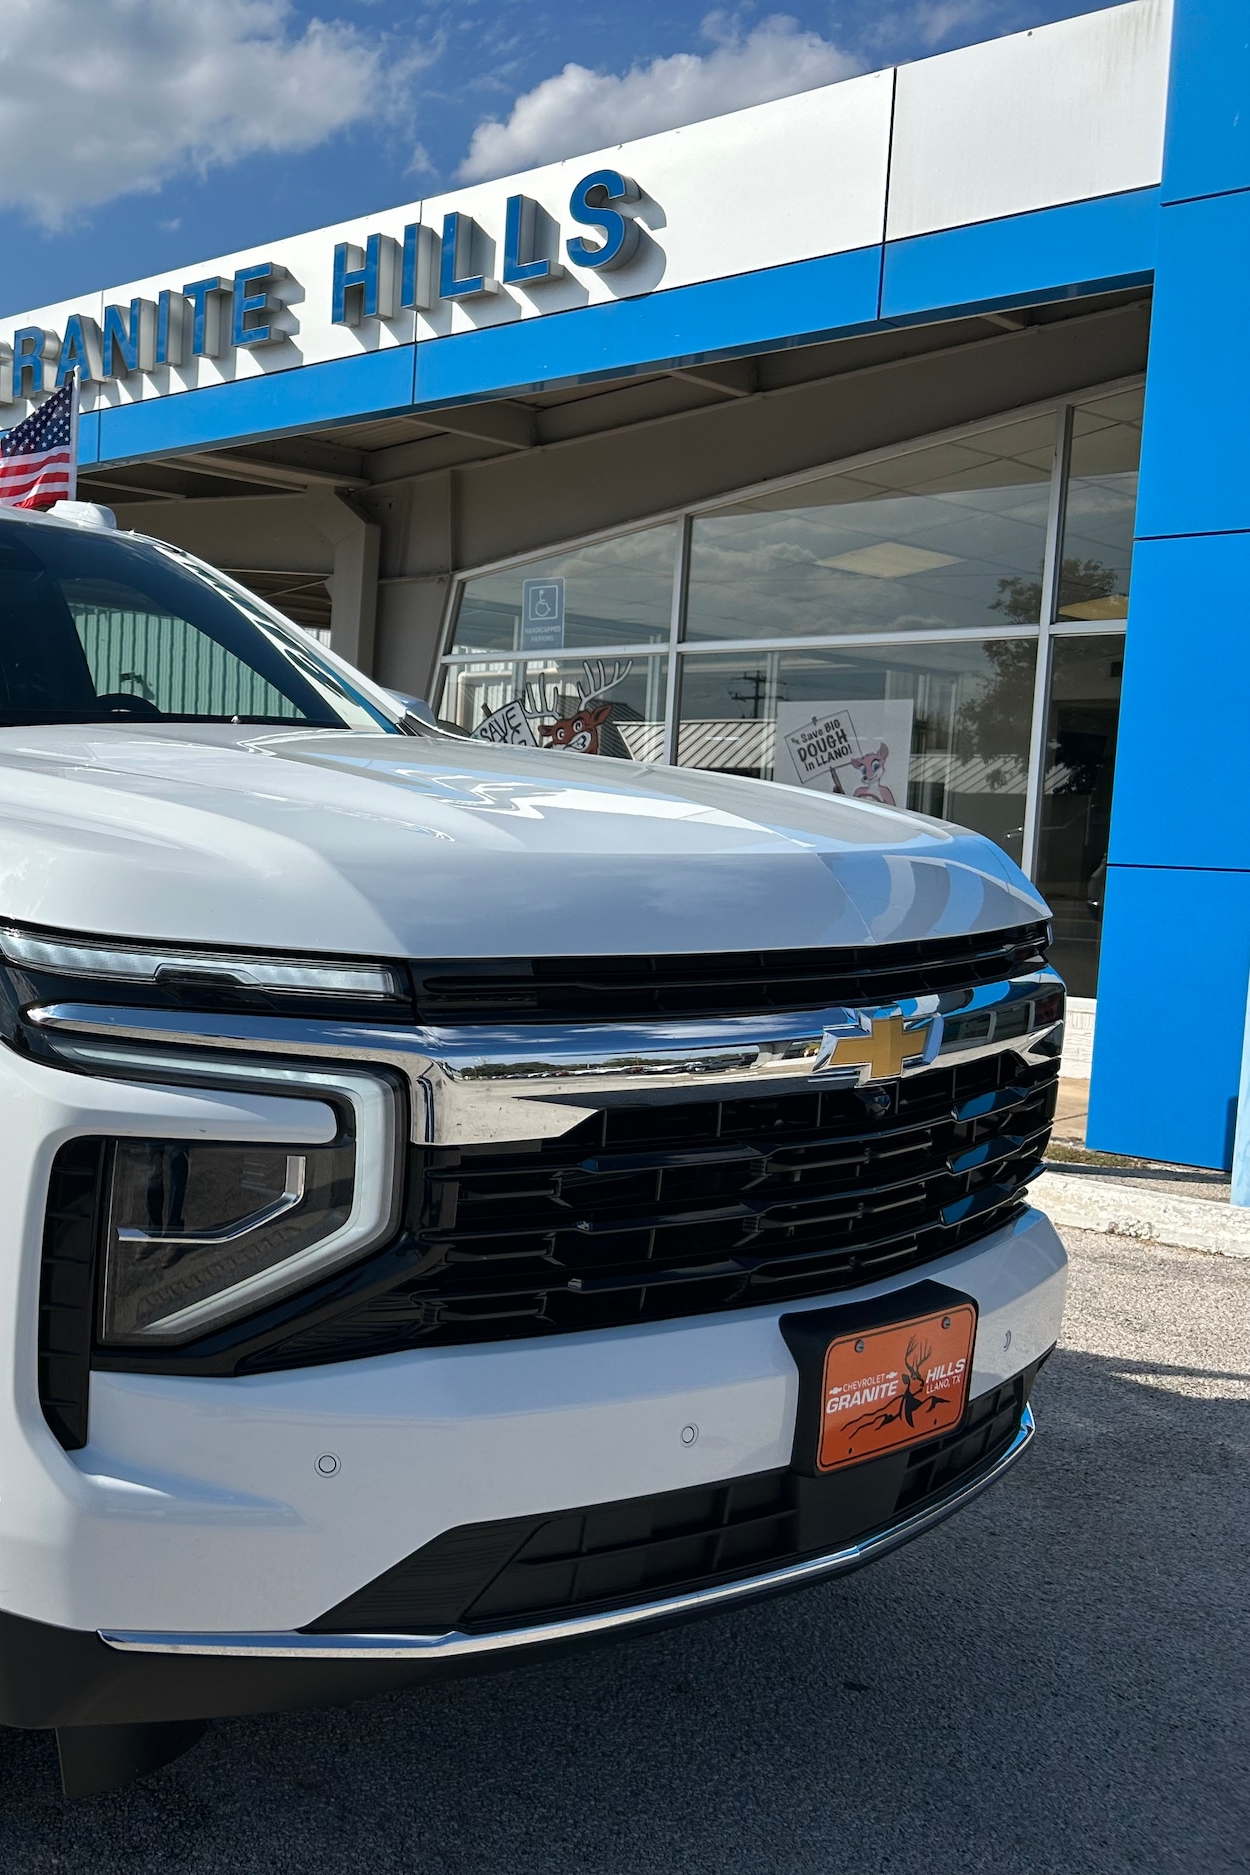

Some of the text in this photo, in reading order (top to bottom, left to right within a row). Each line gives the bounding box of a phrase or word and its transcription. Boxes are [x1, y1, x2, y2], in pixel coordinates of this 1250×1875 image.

[332, 169, 636, 326] HILLS
[480, 706, 522, 742] SAVE
[801, 728, 824, 743] Save
[797, 728, 848, 762] DOUGH
[815, 743, 852, 767] LLANO!
[842, 1373, 885, 1392] CHEVROLET
[925, 1358, 966, 1384] HILLS
[826, 1380, 899, 1414] GRANITE
[926, 1374, 962, 1395] LLANO, TX
